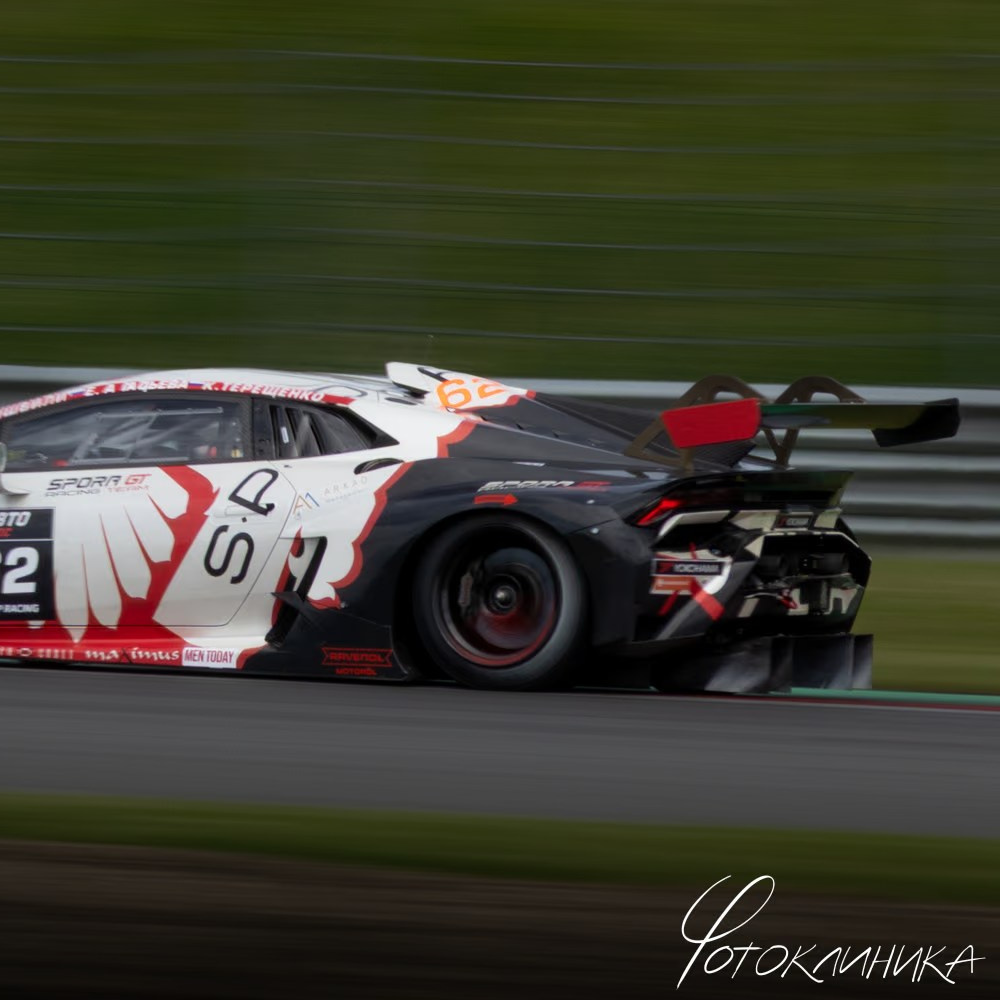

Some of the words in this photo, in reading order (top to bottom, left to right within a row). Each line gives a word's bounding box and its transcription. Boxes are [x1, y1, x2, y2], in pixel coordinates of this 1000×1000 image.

[436, 378, 505, 408] 62
[47, 475, 121, 490] SPORA
[124, 473, 152, 485] GT
[184, 649, 204, 662] MEN
[206, 650, 234, 663] TODAY
